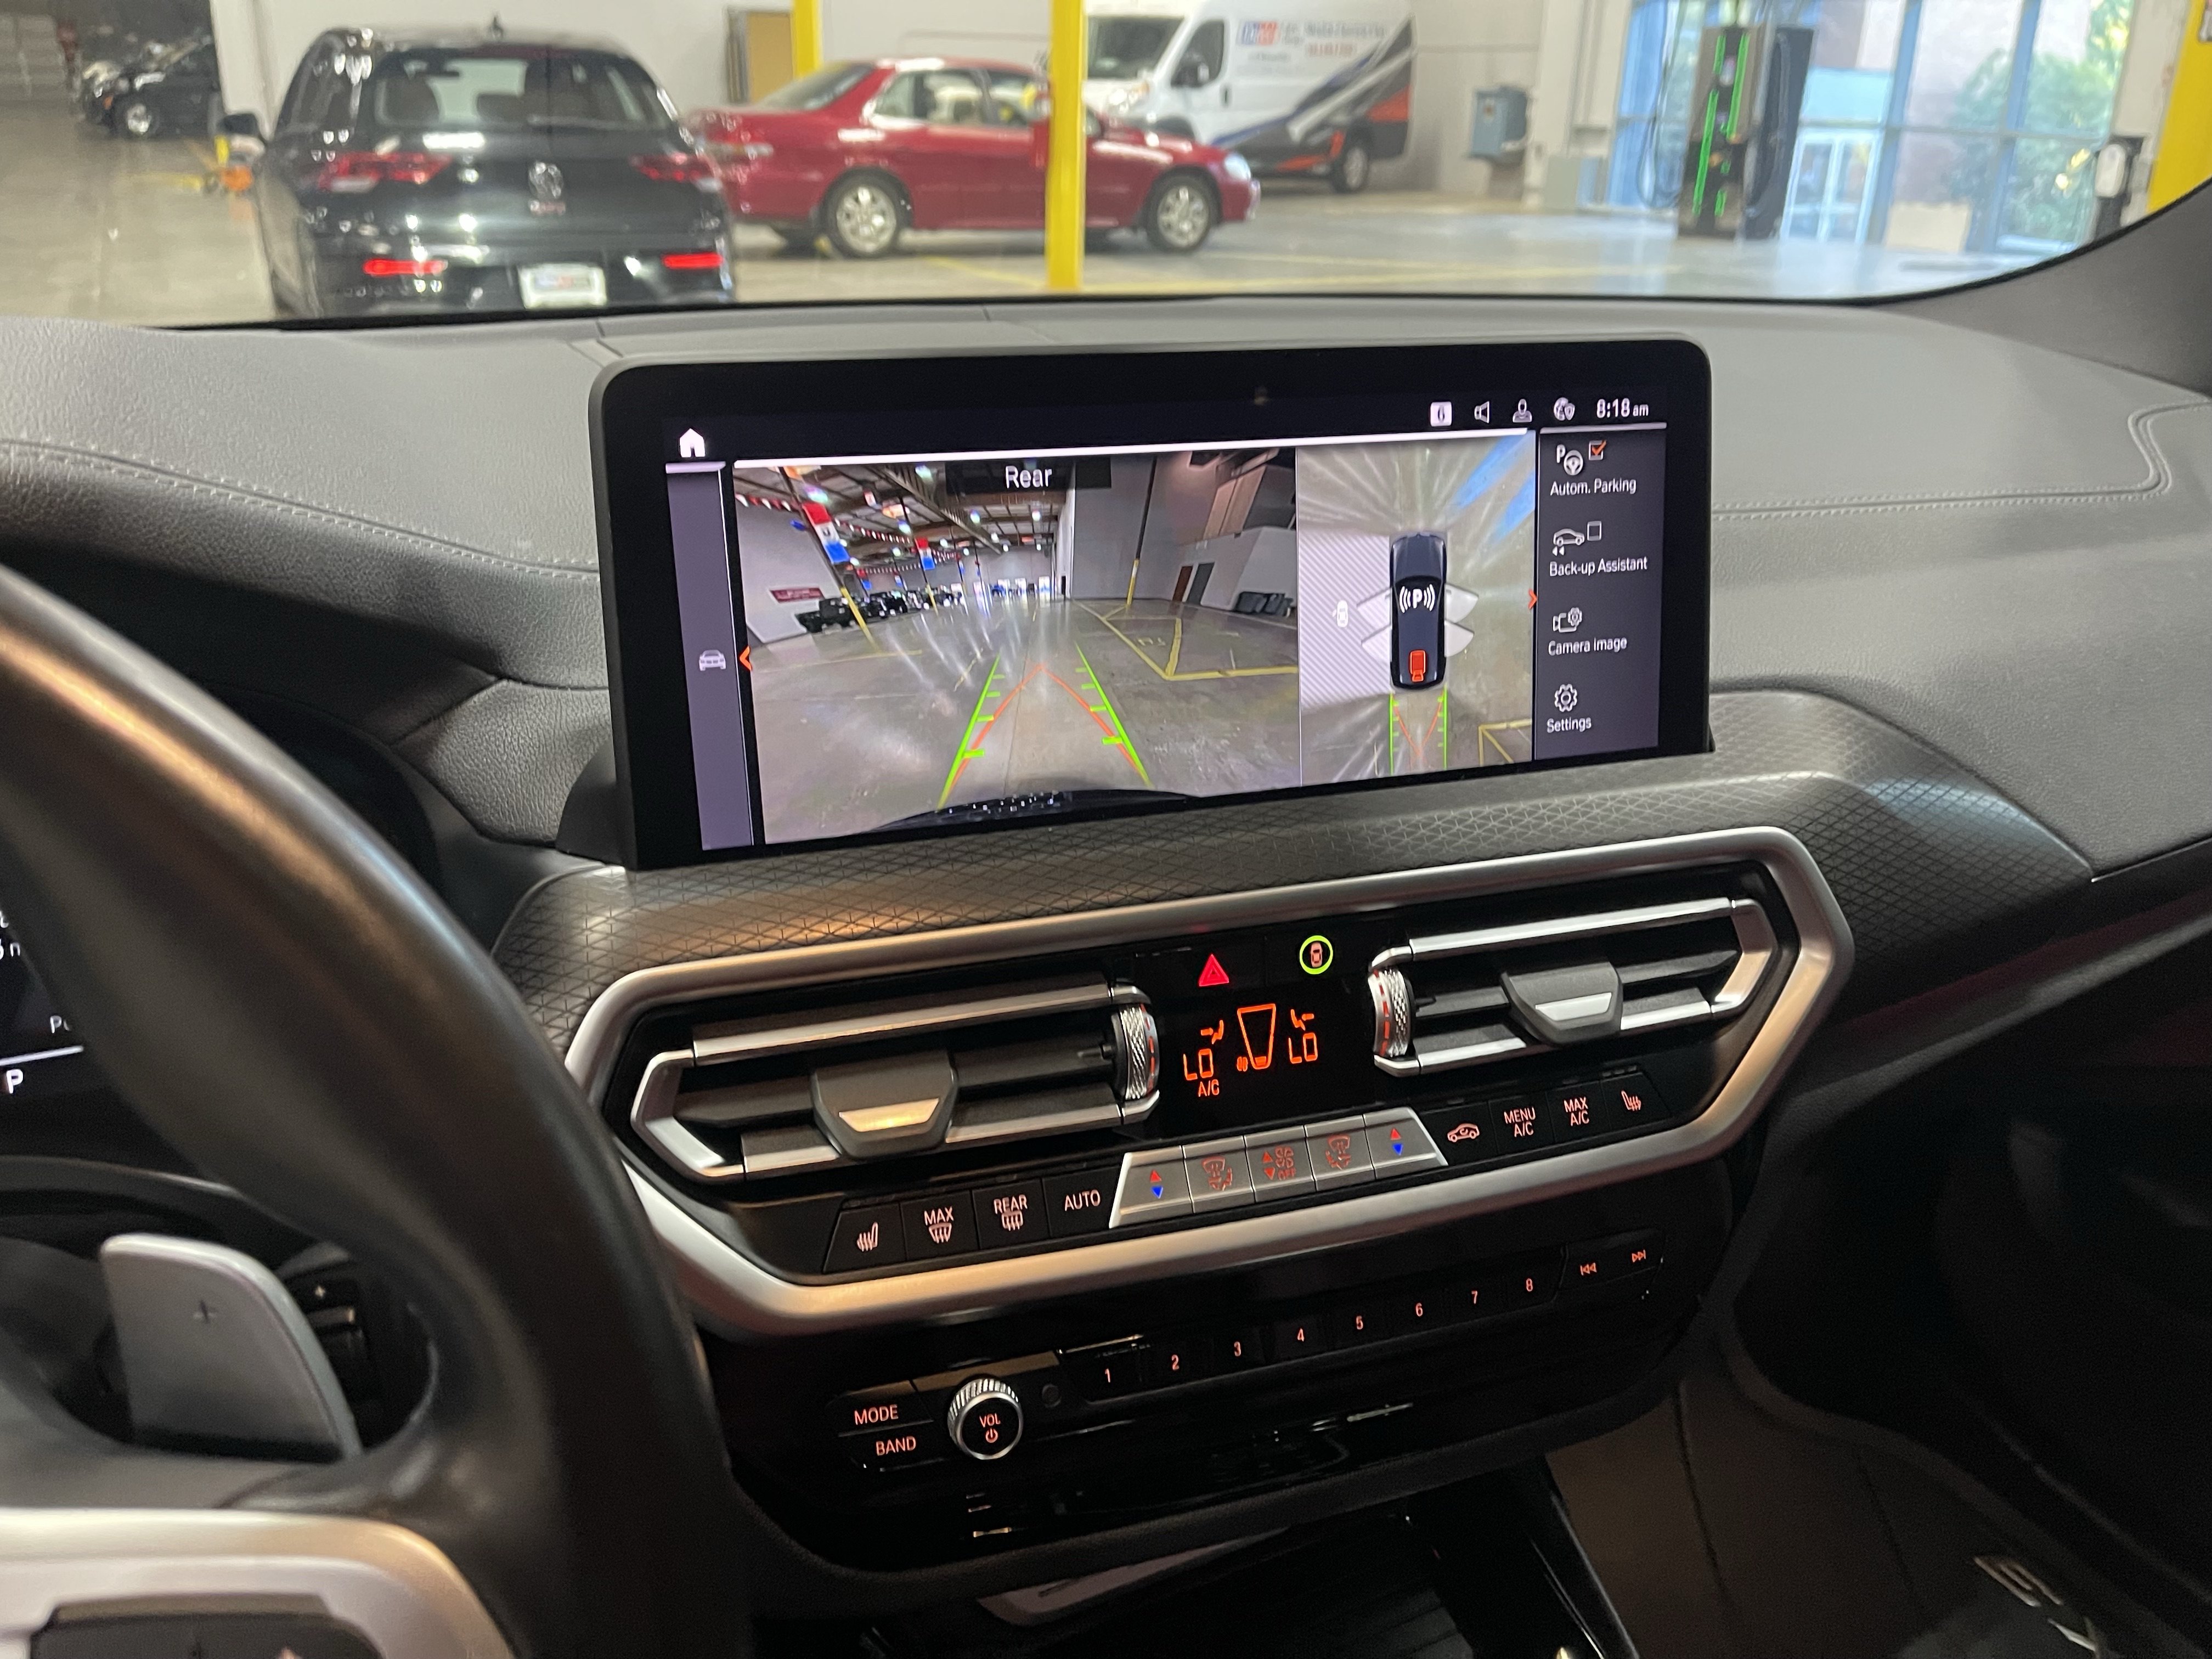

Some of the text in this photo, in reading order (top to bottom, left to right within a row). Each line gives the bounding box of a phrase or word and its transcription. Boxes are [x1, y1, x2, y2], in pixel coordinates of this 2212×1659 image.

[1597, 398, 1649, 418] 8:18 am
[1006, 466, 1052, 488] Rear
[1550, 478, 1636, 495] Autom. Parking
[1550, 556, 1647, 576] Back-up Assistant
[1549, 641, 1590, 656] Camera
[1547, 717, 1591, 732] Settings
[6, 1069, 24, 1094] P
[1198, 1079, 1220, 1097] A/C
[1564, 1097, 1588, 1114] MAX
[1504, 1107, 1536, 1124] MENU
[1570, 1110, 1590, 1126] A/C
[1514, 1122, 1534, 1137] A/C
[1278, 1168, 1296, 1180] OFF
[994, 1194, 1028, 1214] REAR
[1065, 1190, 1100, 1211] AUTO
[924, 1206, 954, 1225] MAX
[1105, 1278, 1533, 1383] 1 2 3 4 5 6 7 8
[855, 1405, 898, 1425] MODE
[980, 1413, 1000, 1427] VOL
[876, 1437, 916, 1455] BAND
